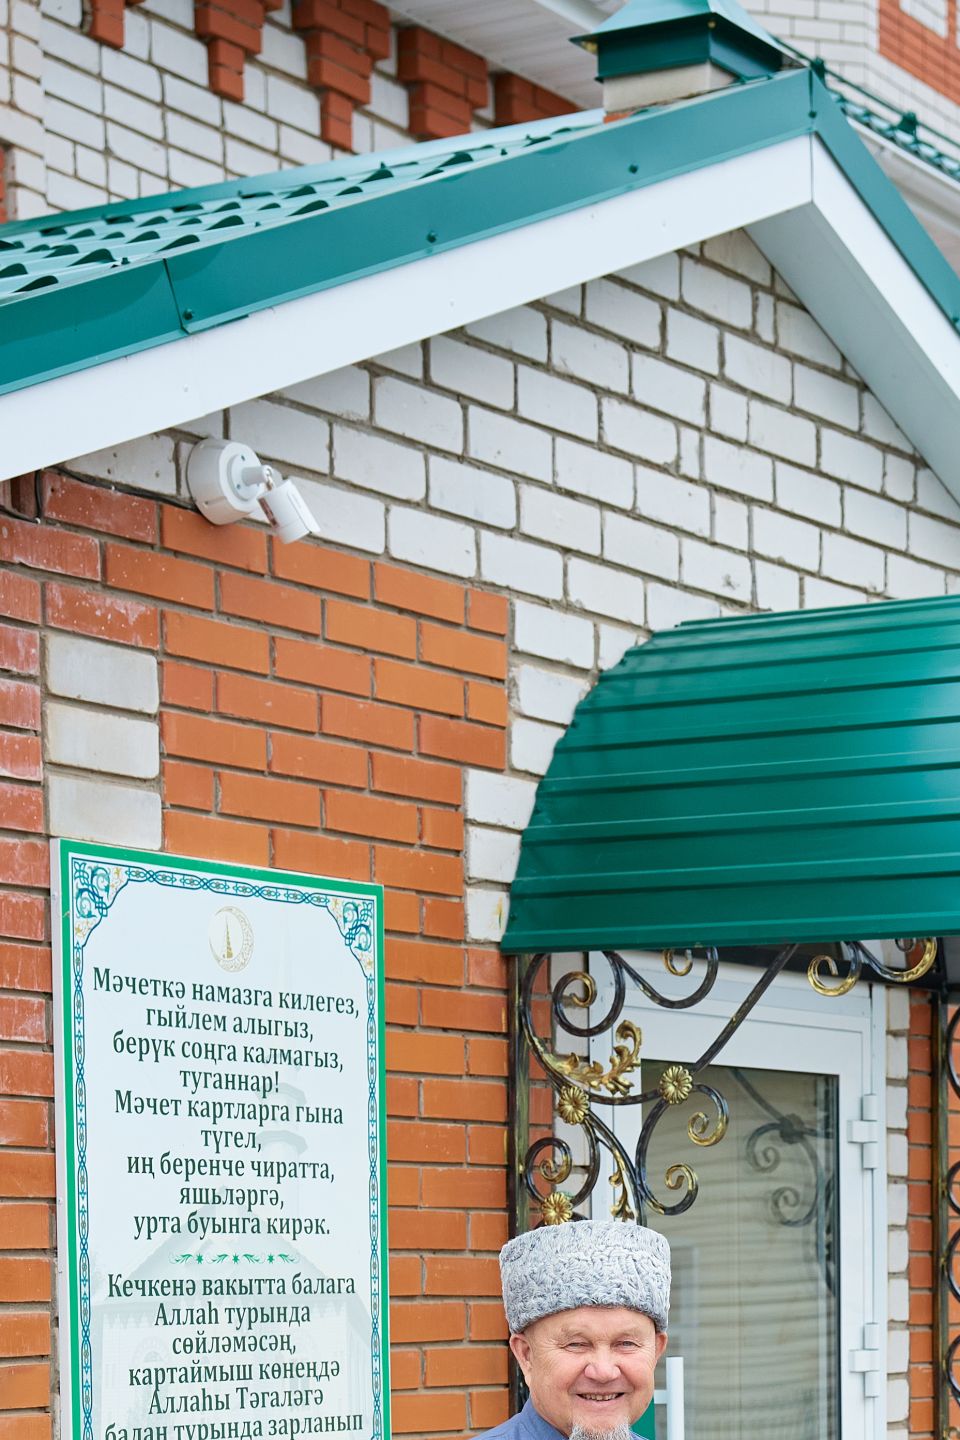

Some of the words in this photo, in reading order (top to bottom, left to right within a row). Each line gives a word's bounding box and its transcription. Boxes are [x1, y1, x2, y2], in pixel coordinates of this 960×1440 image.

[93, 968, 186, 1000] Мәчеткә
[192, 984, 272, 1007] намазга
[279, 992, 359, 1018] килегез,
[146, 1004, 227, 1032] гыйлем
[233, 1017, 314, 1042] алыгыз,
[113, 1030, 175, 1062] берүк
[181, 1041, 238, 1064] соңга
[243, 1047, 343, 1072] калмагыз,
[180, 1069, 280, 1098] туганнар!
[115, 1091, 181, 1116] Мәчет
[188, 1099, 290, 1126] картларга
[296, 1104, 343, 1124] гына
[201, 1128, 262, 1153] түгел,
[128, 1156, 154, 1178] иң
[160, 1153, 245, 1182] беренче
[251, 1161, 335, 1182] чиратта,
[179, 1185, 284, 1211] яшьләргә,
[134, 1215, 181, 1239] урта
[187, 1211, 261, 1240] буынга
[267, 1216, 331, 1240] кирәк.
[108, 1274, 196, 1298] Кечкенә
[202, 1276, 286, 1296] вакытта
[292, 1273, 355, 1295] балага
[155, 1302, 218, 1326] Аллаһ
[224, 1305, 310, 1330] турында
[172, 1331, 296, 1355] сөйләмәсәң,
[129, 1362, 253, 1392] картаймыш
[259, 1359, 340, 1382] көнеңдә
[148, 1388, 230, 1414] Аллаһы
[236, 1386, 323, 1411] Тәгаләгә
[268, 1414, 363, 1440] зарланып
